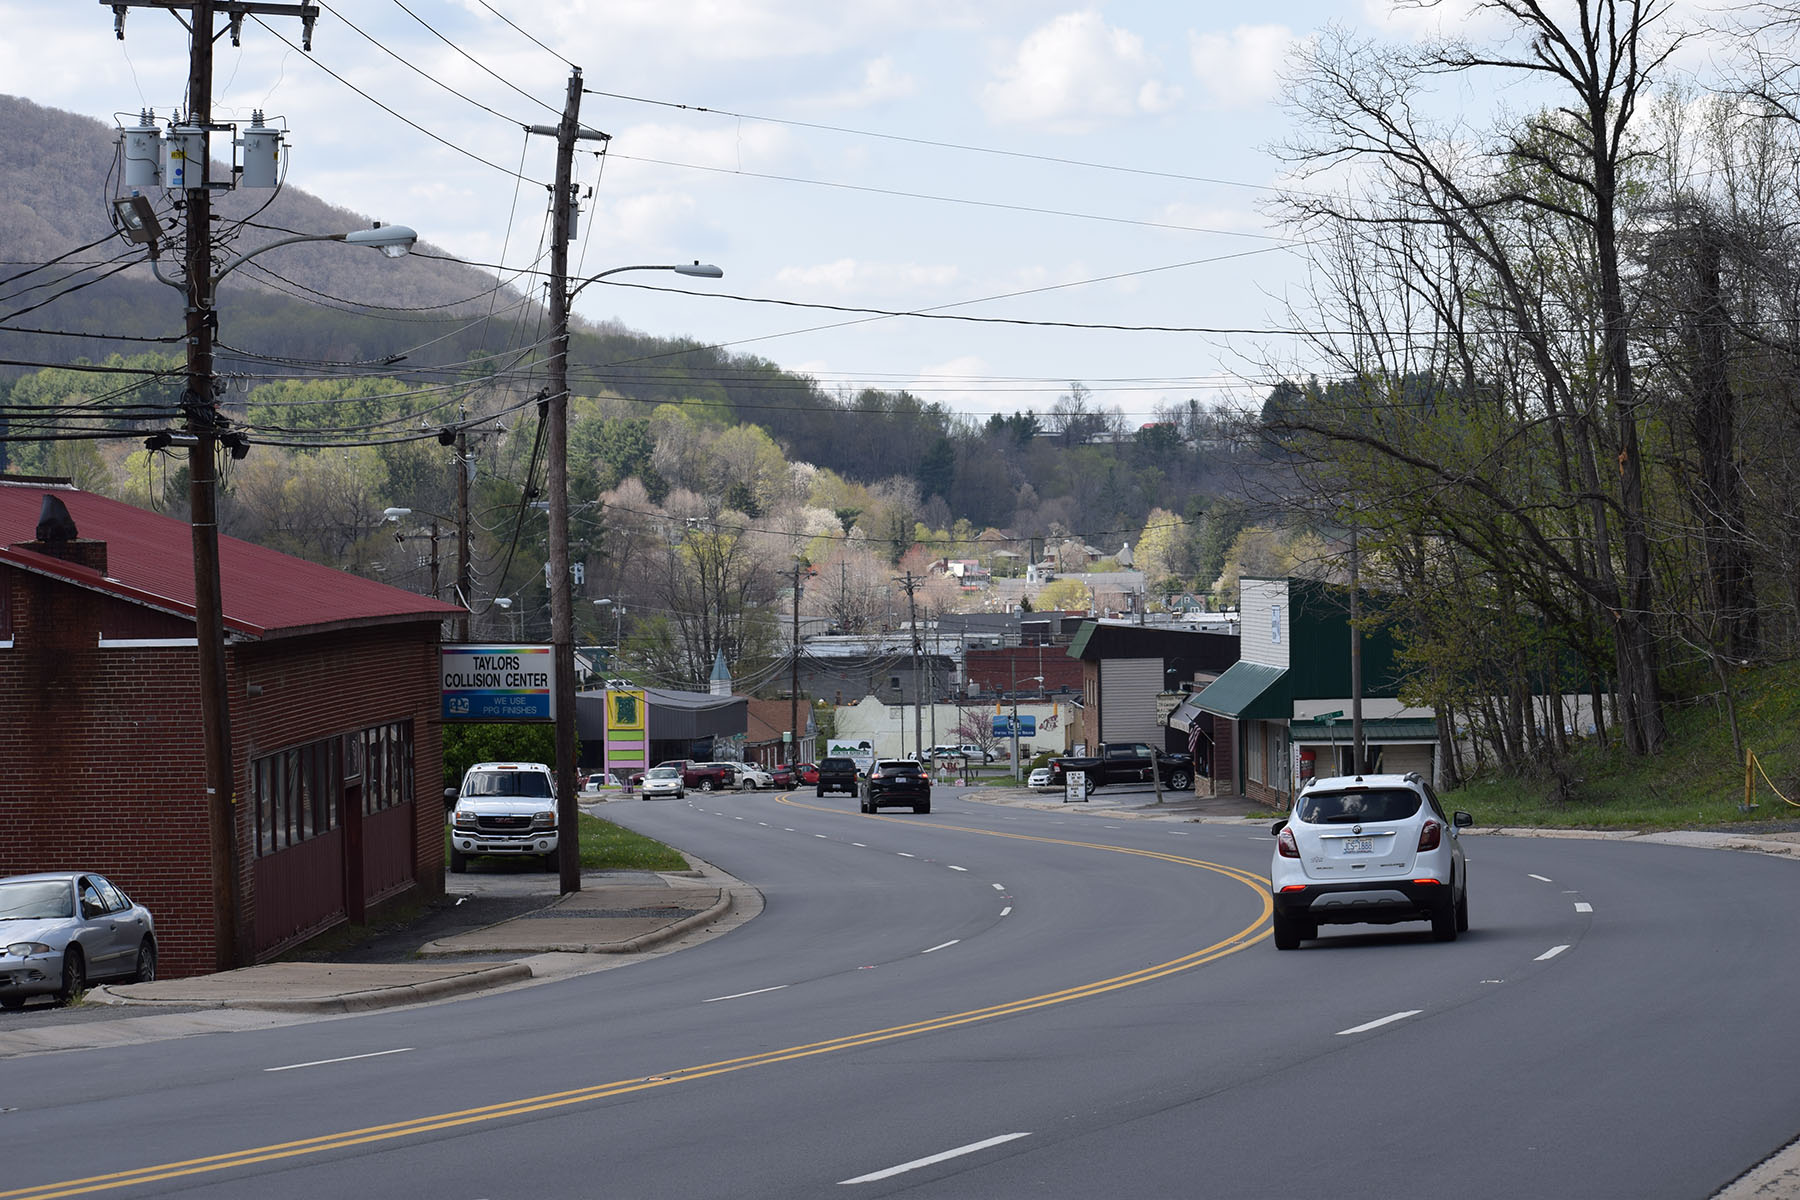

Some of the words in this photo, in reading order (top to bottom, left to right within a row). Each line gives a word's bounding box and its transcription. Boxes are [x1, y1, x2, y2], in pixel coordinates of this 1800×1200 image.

[473, 656, 520, 670] TAYLORS
[445, 673, 500, 688] COLLISION
[505, 673, 548, 687] CENTER
[494, 697, 507, 705] WE
[510, 697, 526, 705] USE
[483, 706, 499, 714] PPG
[502, 706, 537, 714] FINISHES
